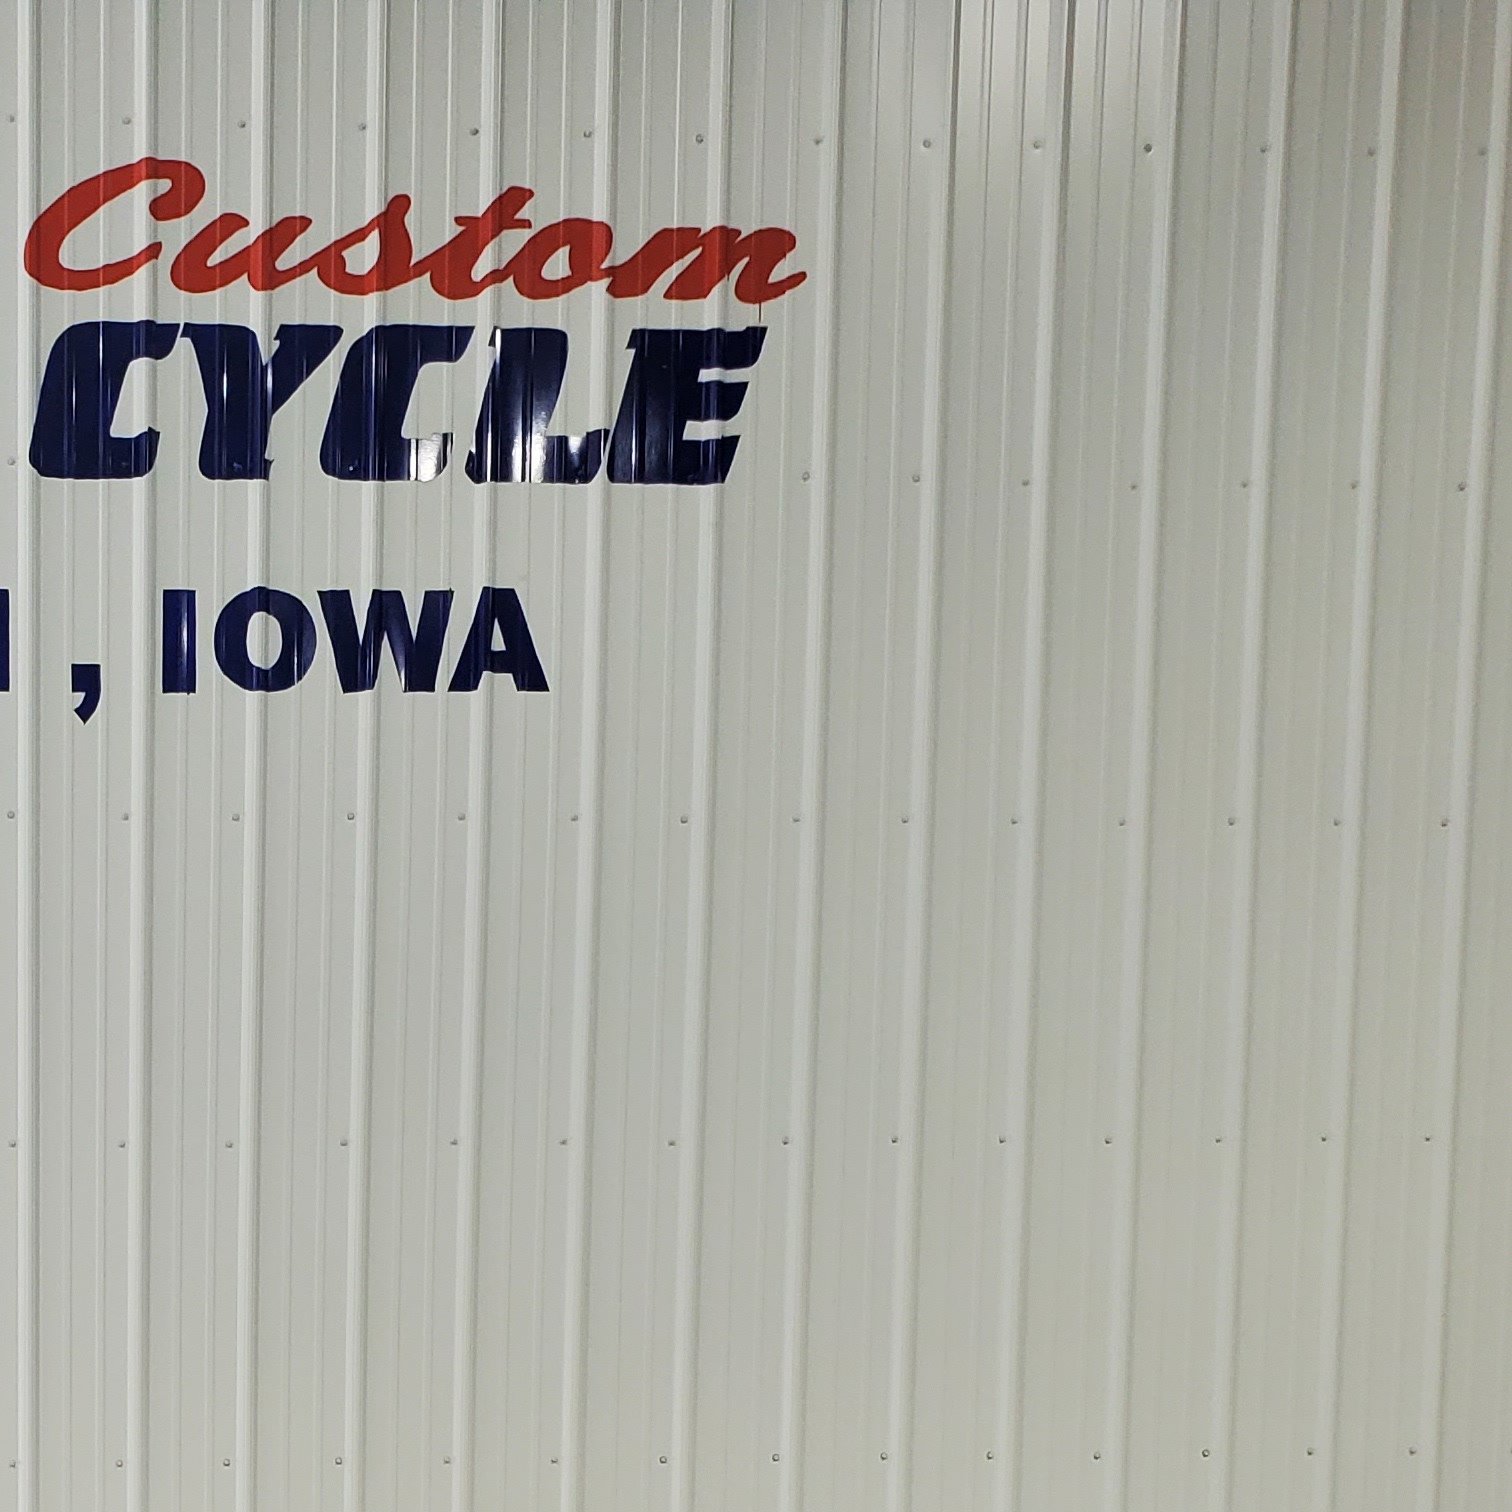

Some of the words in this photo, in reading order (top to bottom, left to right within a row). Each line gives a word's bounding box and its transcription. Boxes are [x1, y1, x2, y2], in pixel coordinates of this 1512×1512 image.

[24, 157, 806, 303] Custom
[29, 320, 767, 485] CYCLE
[162, 586, 550, 695] IOWA
